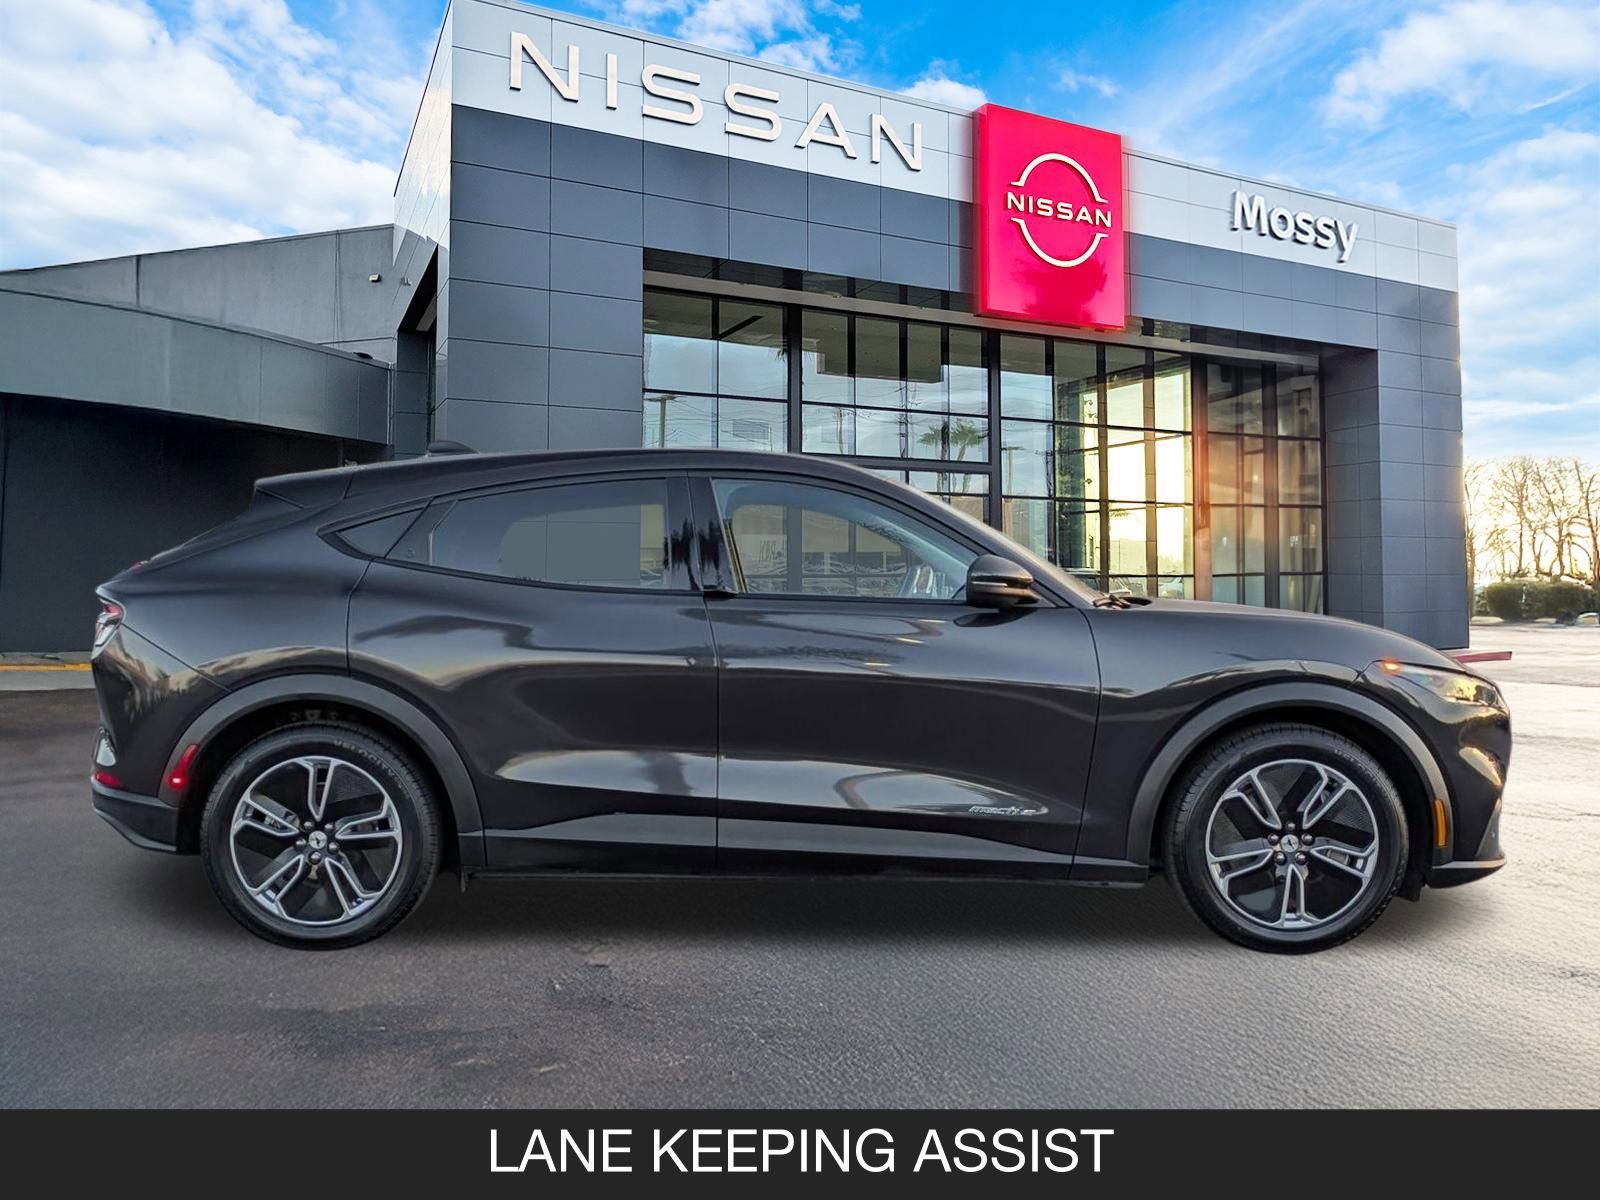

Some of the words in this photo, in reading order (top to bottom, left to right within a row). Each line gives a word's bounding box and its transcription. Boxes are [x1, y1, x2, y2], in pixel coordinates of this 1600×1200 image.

[509, 31, 923, 172] NISSAN
[1006, 191, 1113, 228] NISSAN
[1231, 190, 1360, 263] Mossy
